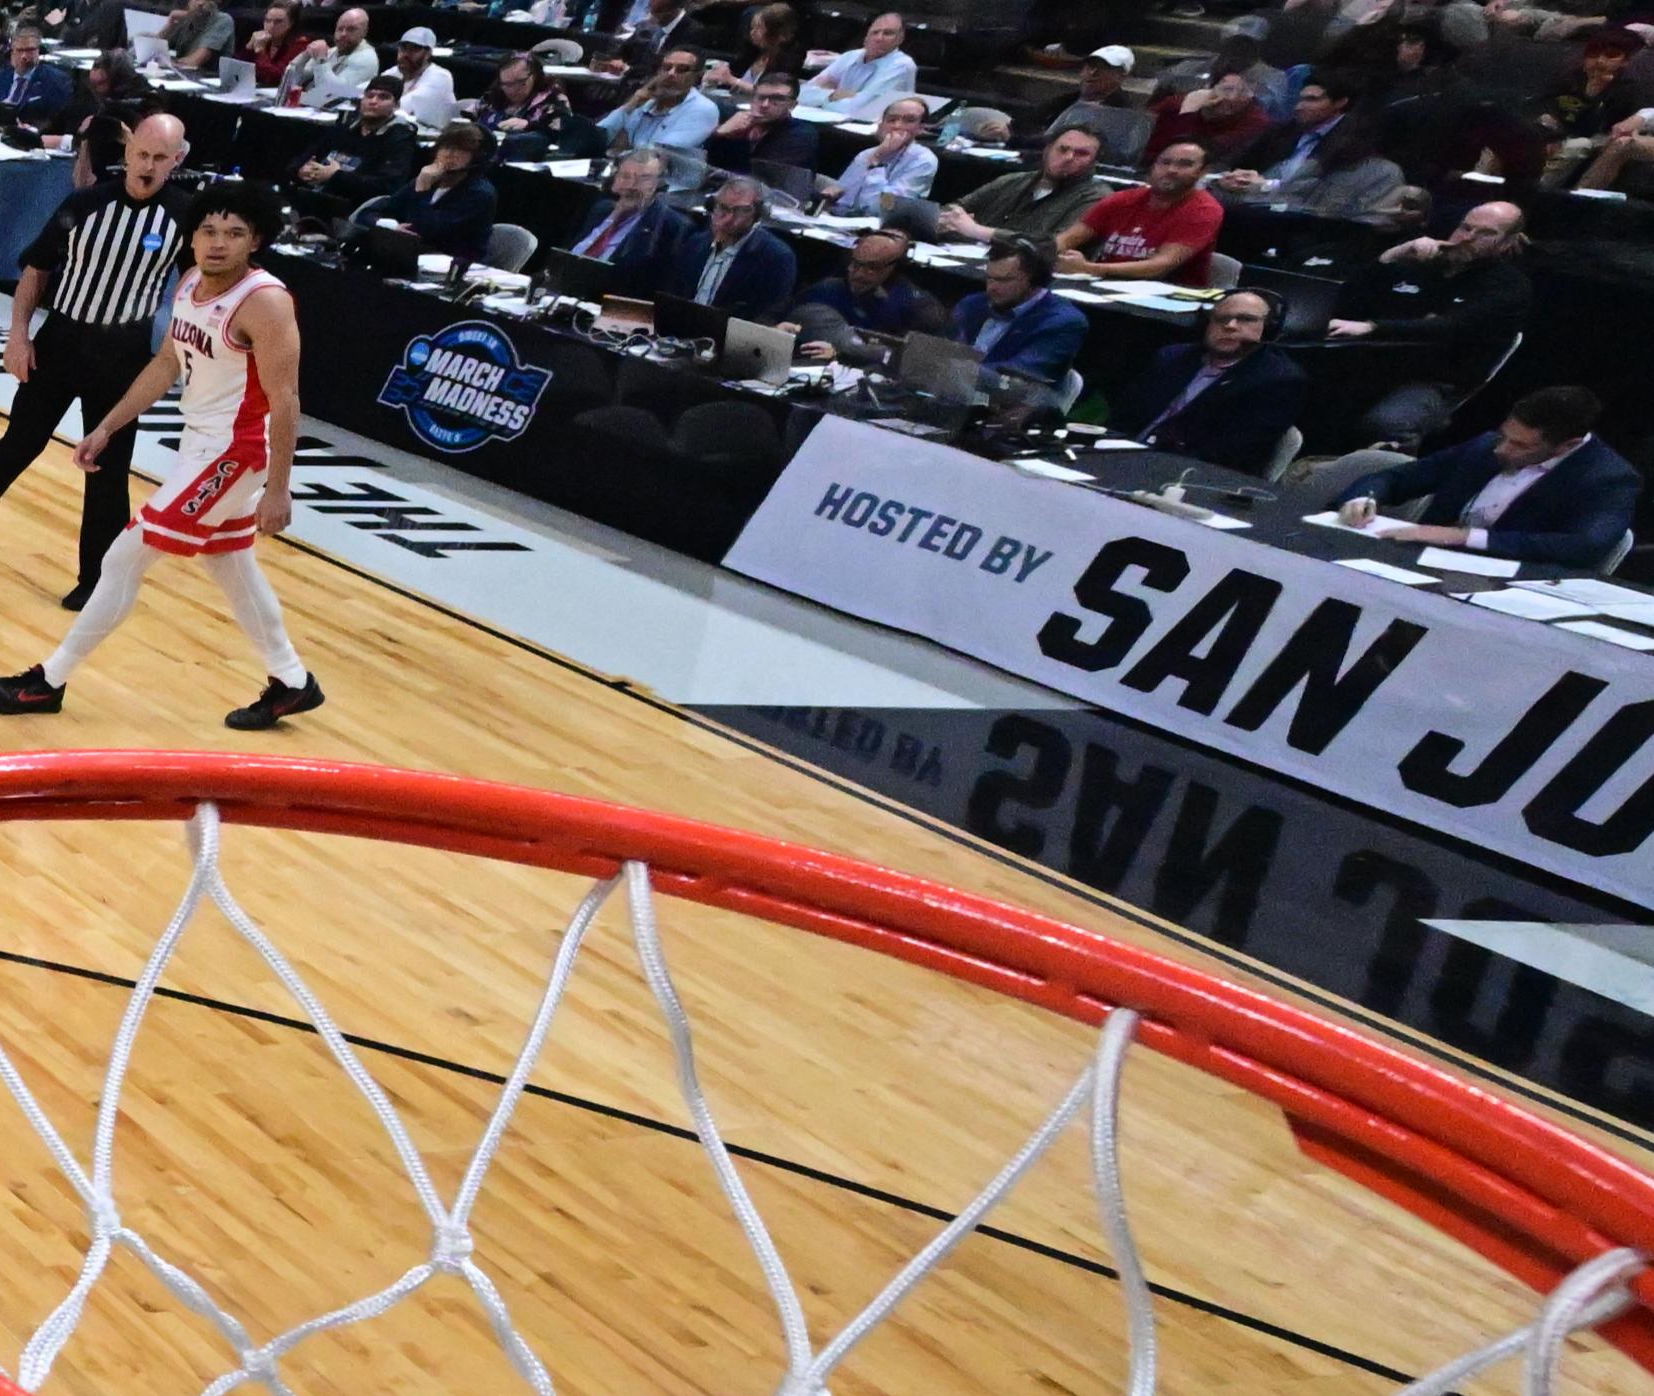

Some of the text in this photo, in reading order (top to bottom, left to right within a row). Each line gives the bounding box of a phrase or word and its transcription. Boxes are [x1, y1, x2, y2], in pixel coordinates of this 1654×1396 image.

[171, 317, 215, 360] RIZONA
[183, 349, 193, 386] 5
[424, 348, 506, 392] MARCH
[423, 377, 531, 431] MADNESS
[180, 460, 240, 516] CATS
[290, 482, 535, 559] THE
[813, 482, 983, 561] HOSTED
[979, 535, 1055, 583] BY
[1036, 535, 1429, 757] SAN
